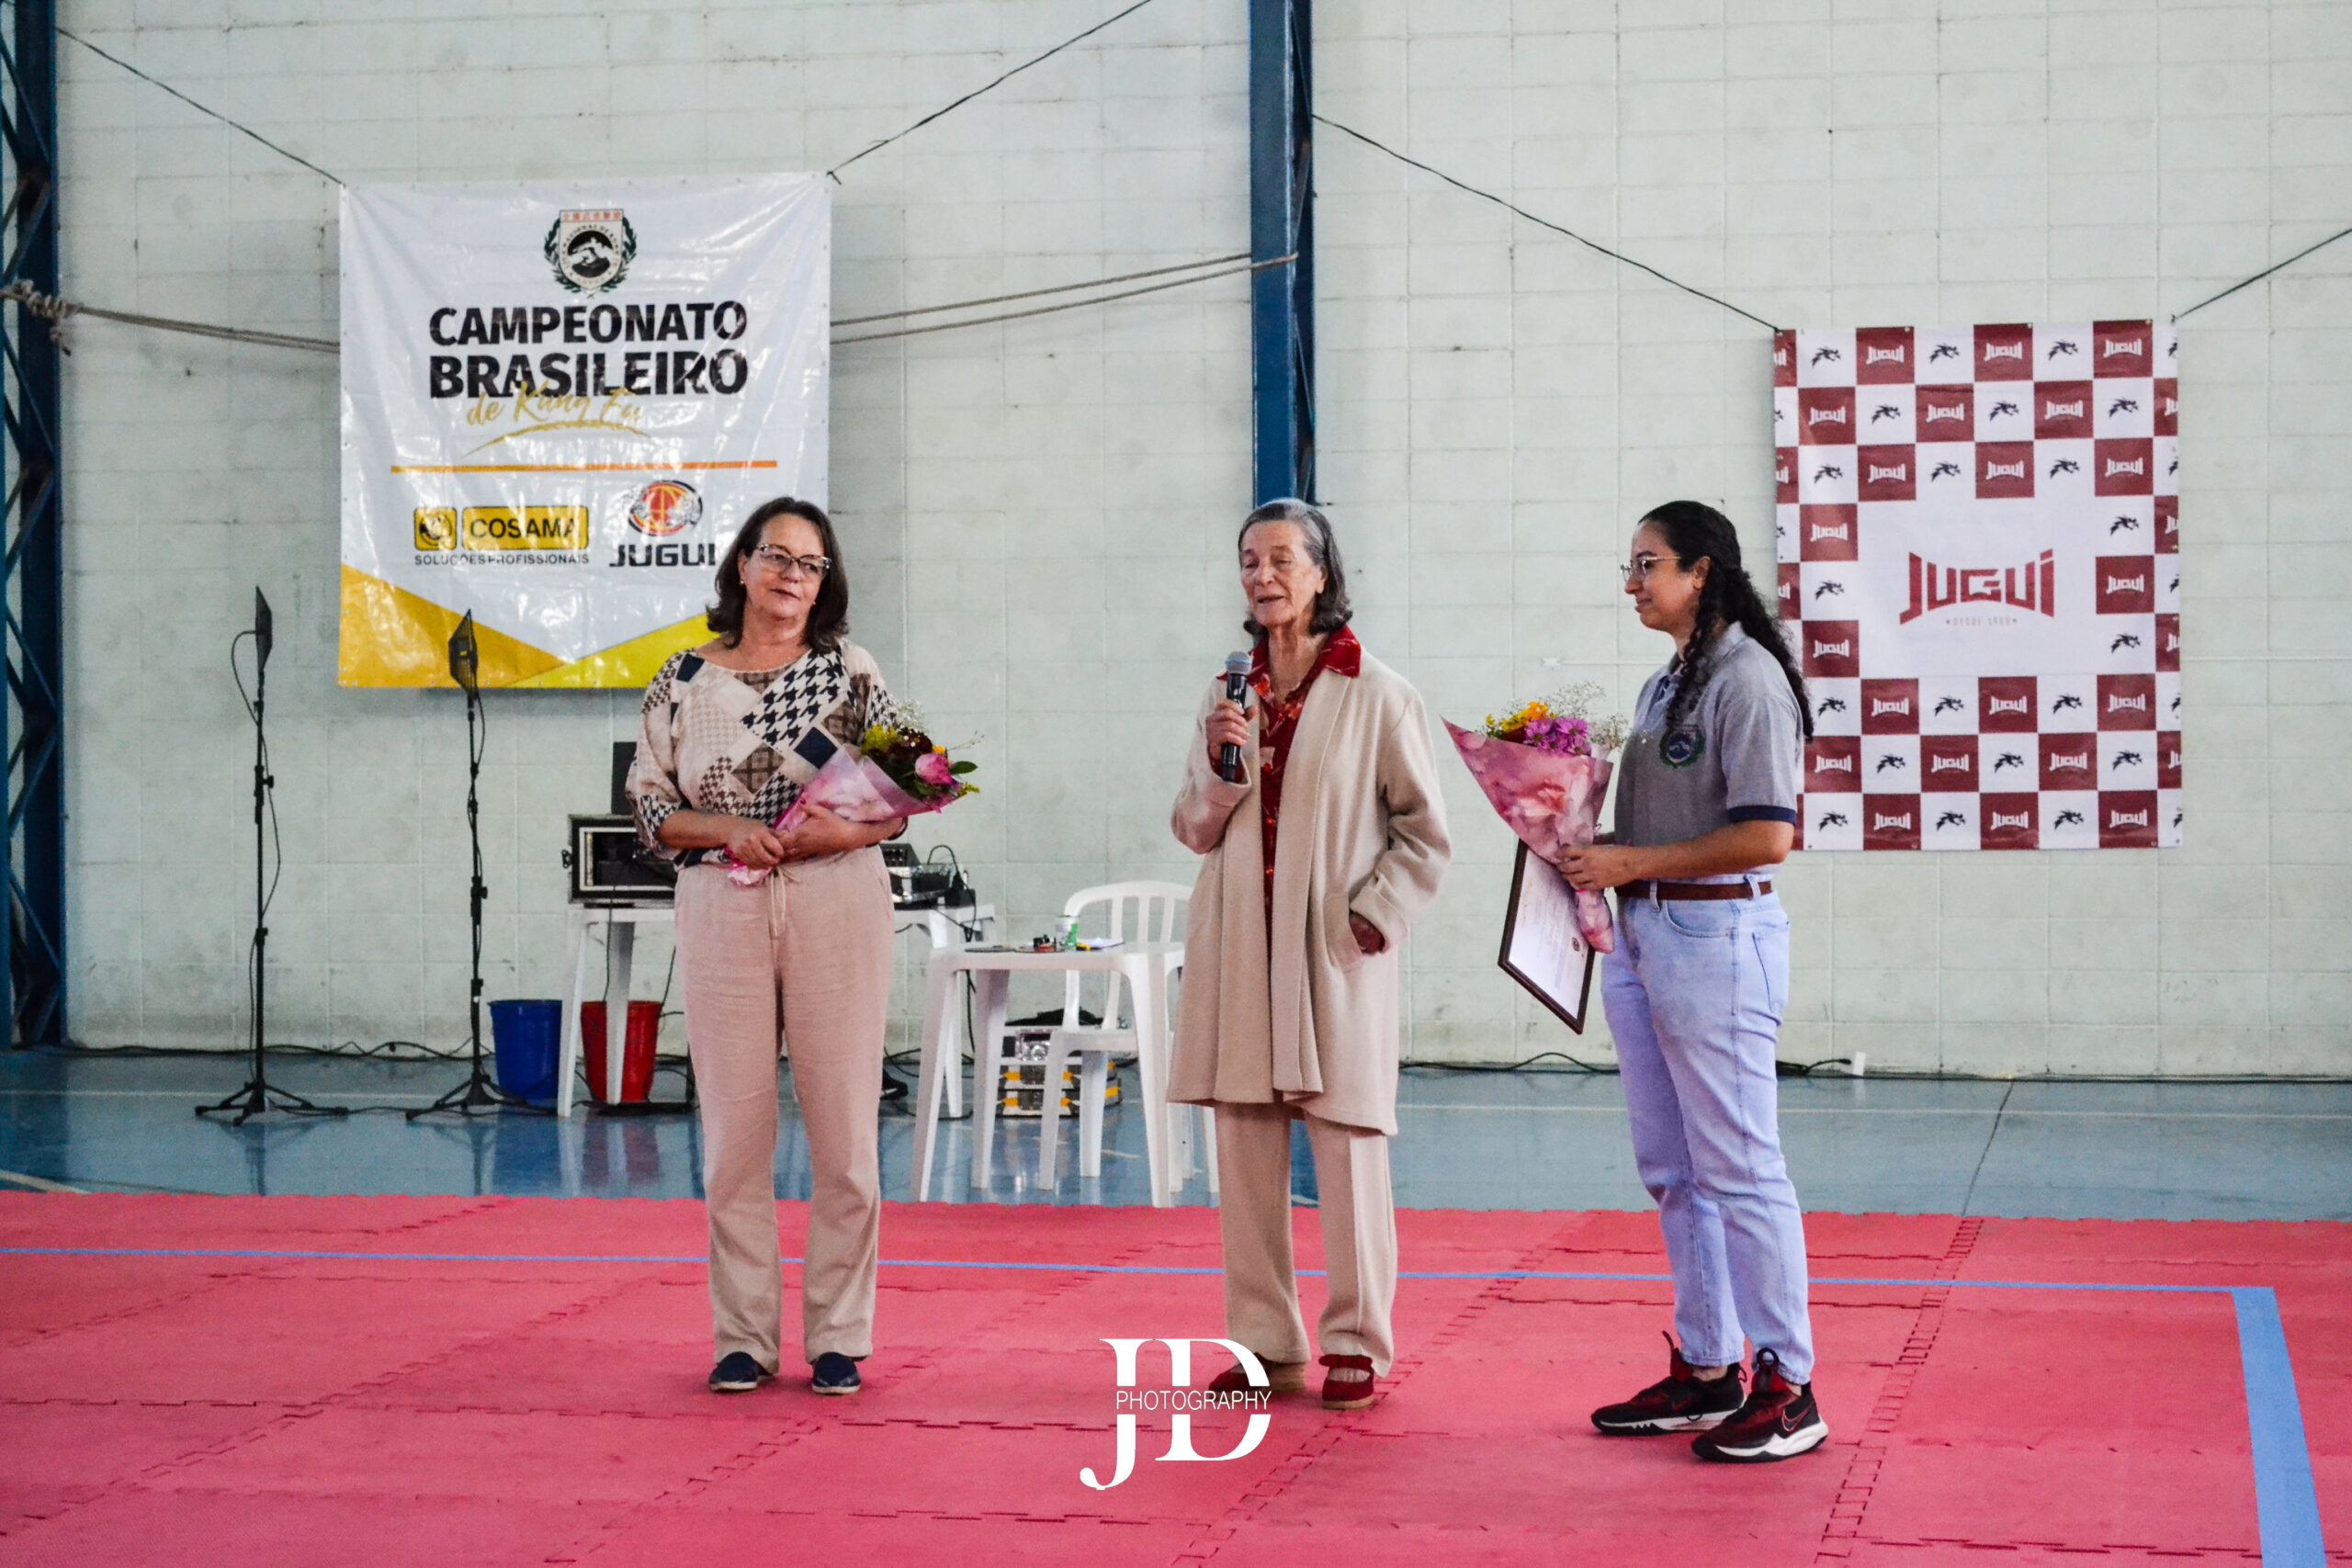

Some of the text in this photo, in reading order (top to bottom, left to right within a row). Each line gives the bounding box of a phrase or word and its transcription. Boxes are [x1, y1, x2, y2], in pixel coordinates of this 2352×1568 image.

[429, 300, 747, 346] CAMPEONATO
[429, 348, 749, 399] BRASILEIRO
[466, 380, 647, 426] de Kung Fu
[469, 518, 582, 538] COSAMA
[488, 554, 590, 565] PROFISSIONAIS
[609, 543, 716, 567] JUGUI
